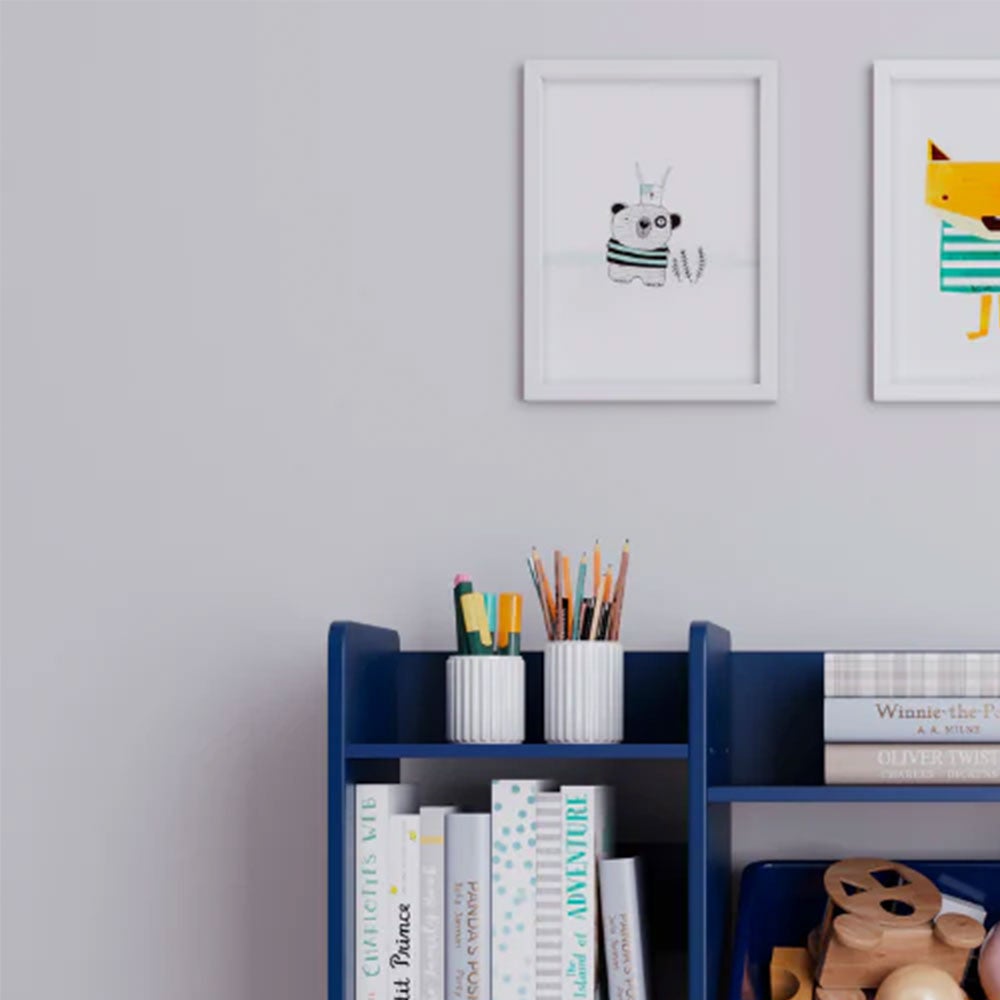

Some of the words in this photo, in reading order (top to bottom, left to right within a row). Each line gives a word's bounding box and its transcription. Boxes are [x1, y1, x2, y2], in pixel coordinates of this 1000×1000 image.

[877, 750, 943, 766] OLIVER
[949, 750, 999, 766] TWIST
[565, 793, 589, 920] ADVENTURE
[389, 903, 412, 969] Prince
